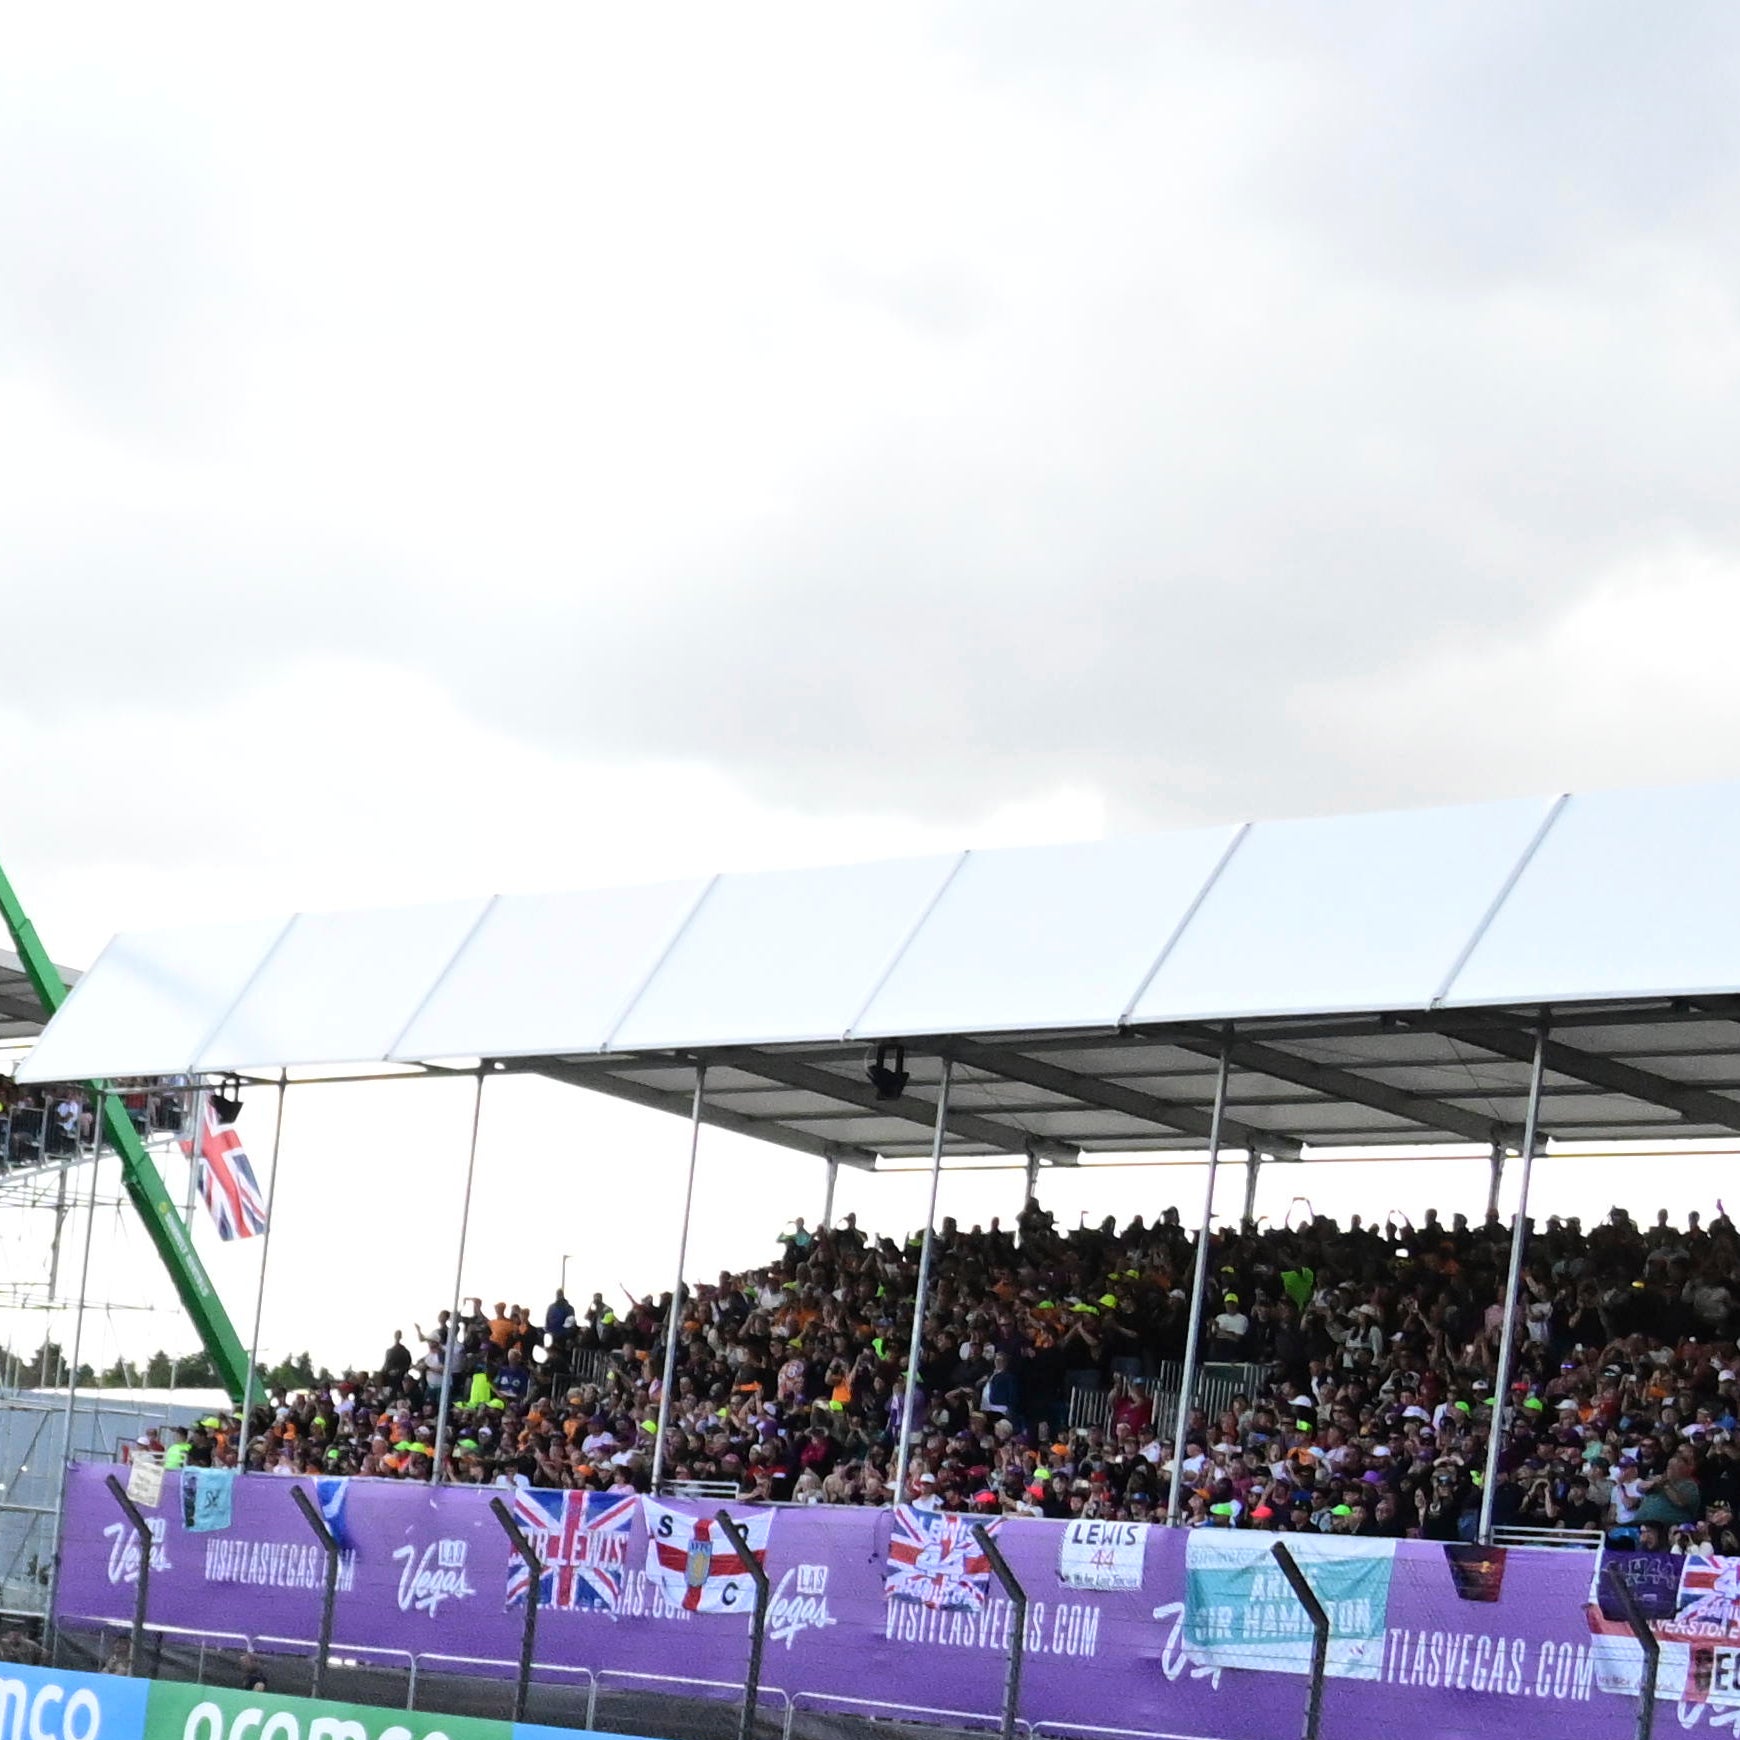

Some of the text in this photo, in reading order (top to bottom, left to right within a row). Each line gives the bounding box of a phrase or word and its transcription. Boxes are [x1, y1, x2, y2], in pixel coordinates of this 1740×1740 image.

[658, 1514, 674, 1538] S
[1072, 1523, 1139, 1546] LEWIS
[103, 1522, 172, 1584] Veas
[204, 1538, 356, 1592] VISITLASVEGAS.M
[557, 1527, 628, 1569] LEWIS
[1090, 1549, 1116, 1571] 44
[393, 1543, 475, 1618] Vegas
[722, 1581, 739, 1606] C
[796, 1564, 828, 1594] LAS
[885, 1597, 1101, 1658] VISITLASVES.COM
[1243, 1598, 1371, 1639] HAMITON
[1388, 1627, 1595, 1701] TLASVEGAS.COM
